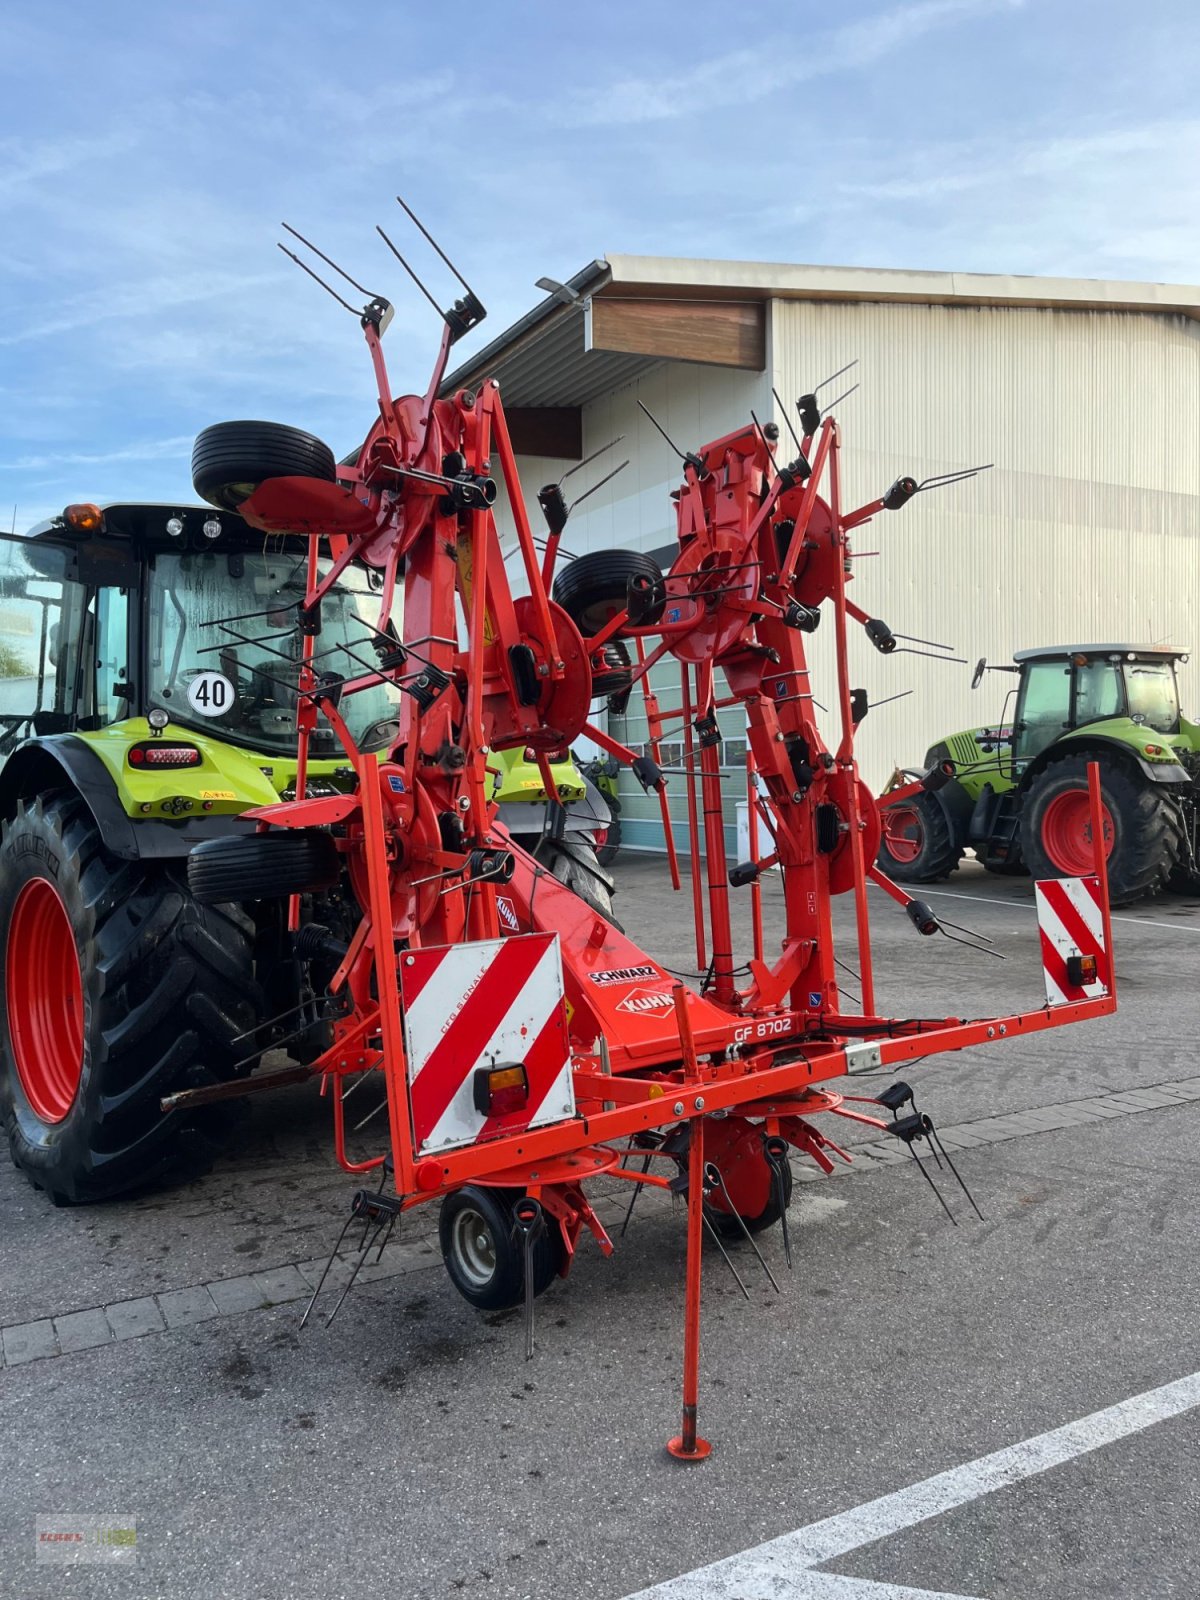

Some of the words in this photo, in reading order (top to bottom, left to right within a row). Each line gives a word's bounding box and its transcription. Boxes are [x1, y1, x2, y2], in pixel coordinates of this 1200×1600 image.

[195, 679, 225, 707] 40
[497, 897, 517, 928] KUHN
[590, 966, 656, 982] SCHWARZ
[623, 993, 675, 1012] KUHN
[734, 1026, 753, 1041] GF
[757, 1018, 791, 1037] 8702
